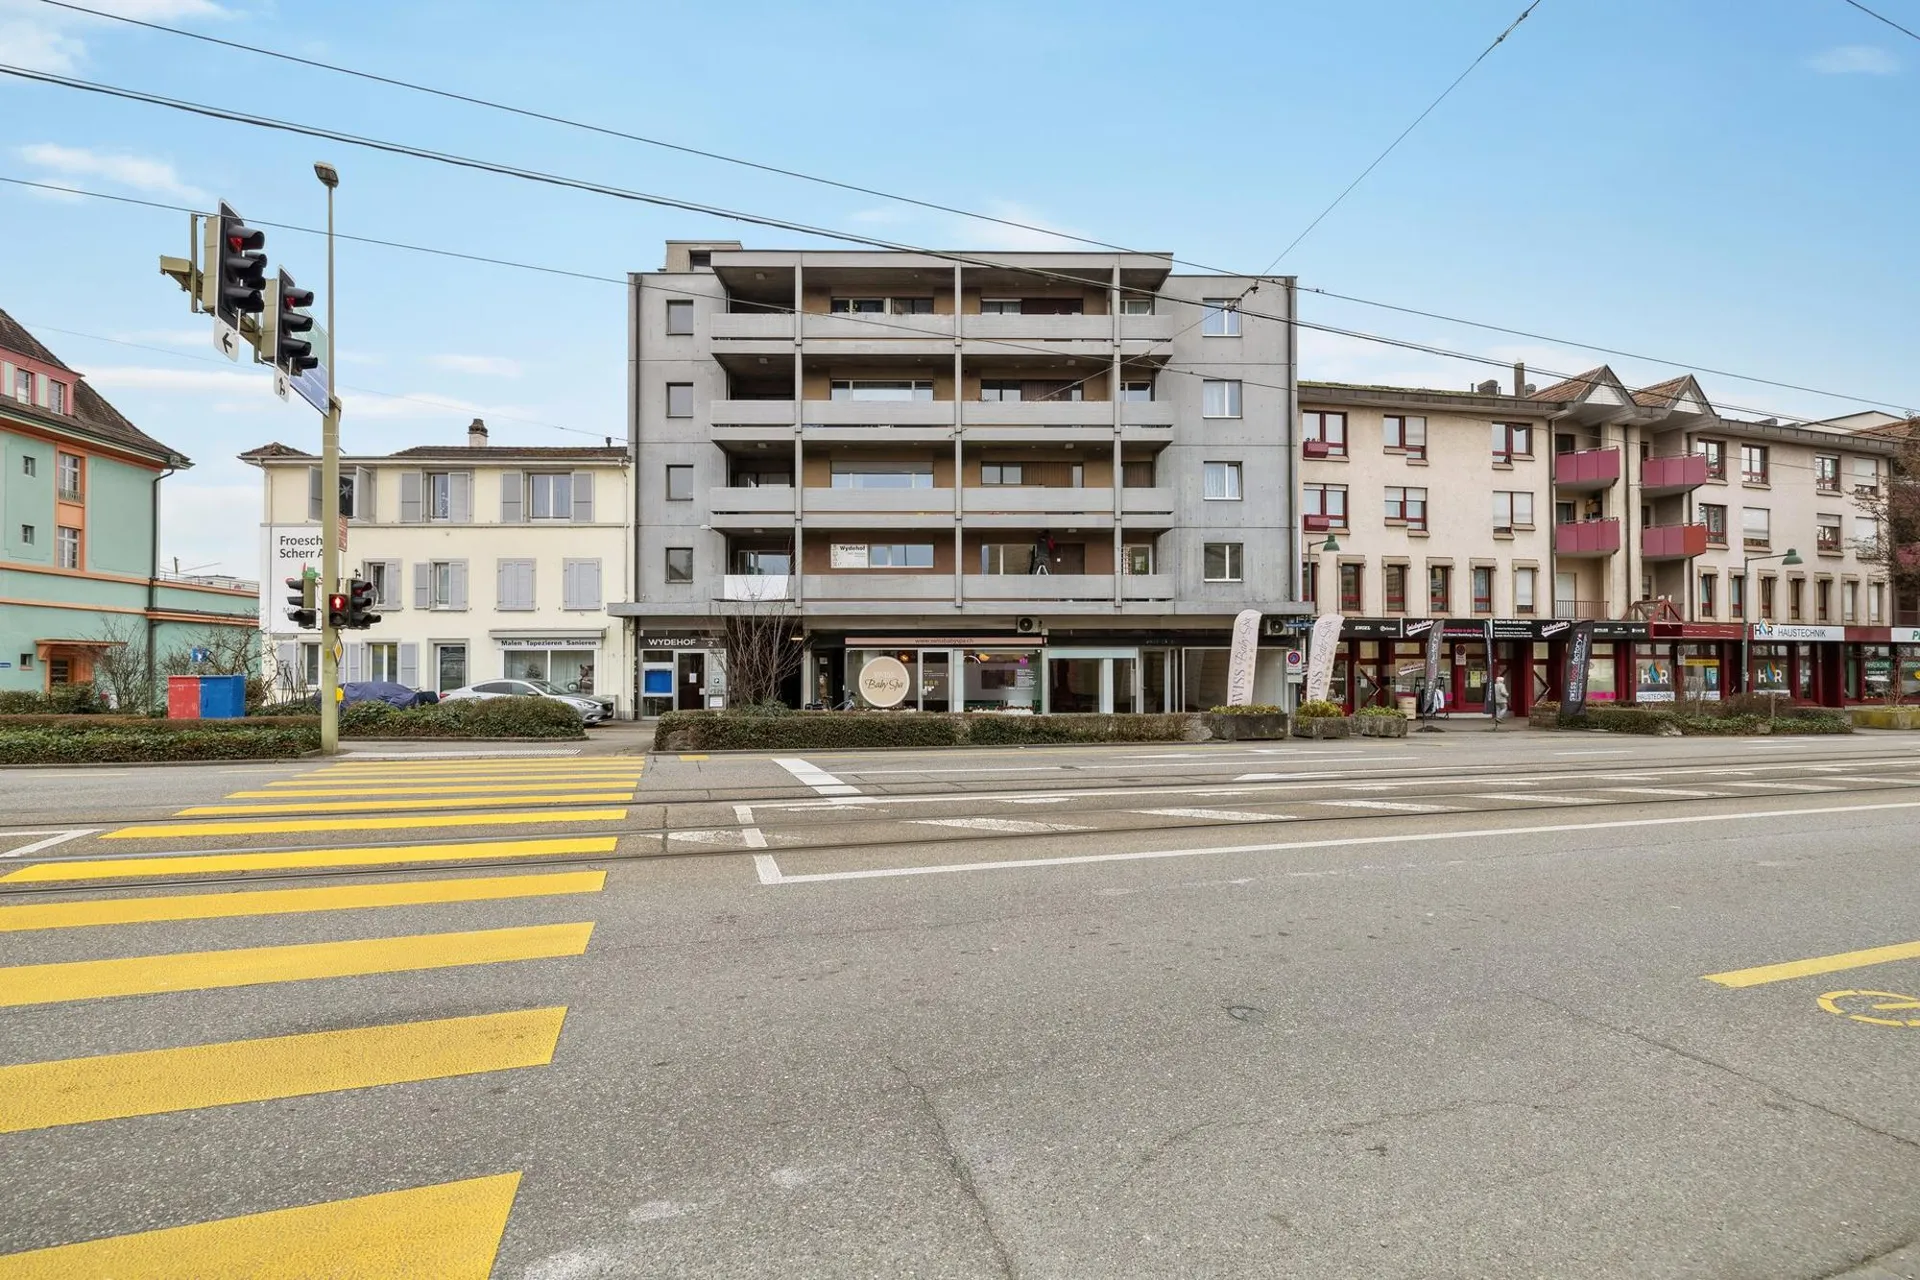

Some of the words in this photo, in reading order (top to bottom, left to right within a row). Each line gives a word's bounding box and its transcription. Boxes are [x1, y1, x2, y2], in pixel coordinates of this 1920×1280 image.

[279, 549, 315, 560] Scherr
[1777, 628, 1826, 638] HAUSTECHNIK
[526, 640, 562, 648] Tapezieren
[648, 638, 697, 646] WYDEHOF
[865, 678, 888, 692] Baby
[888, 678, 904, 692] Spa
[1231, 669, 1245, 705] WISS
